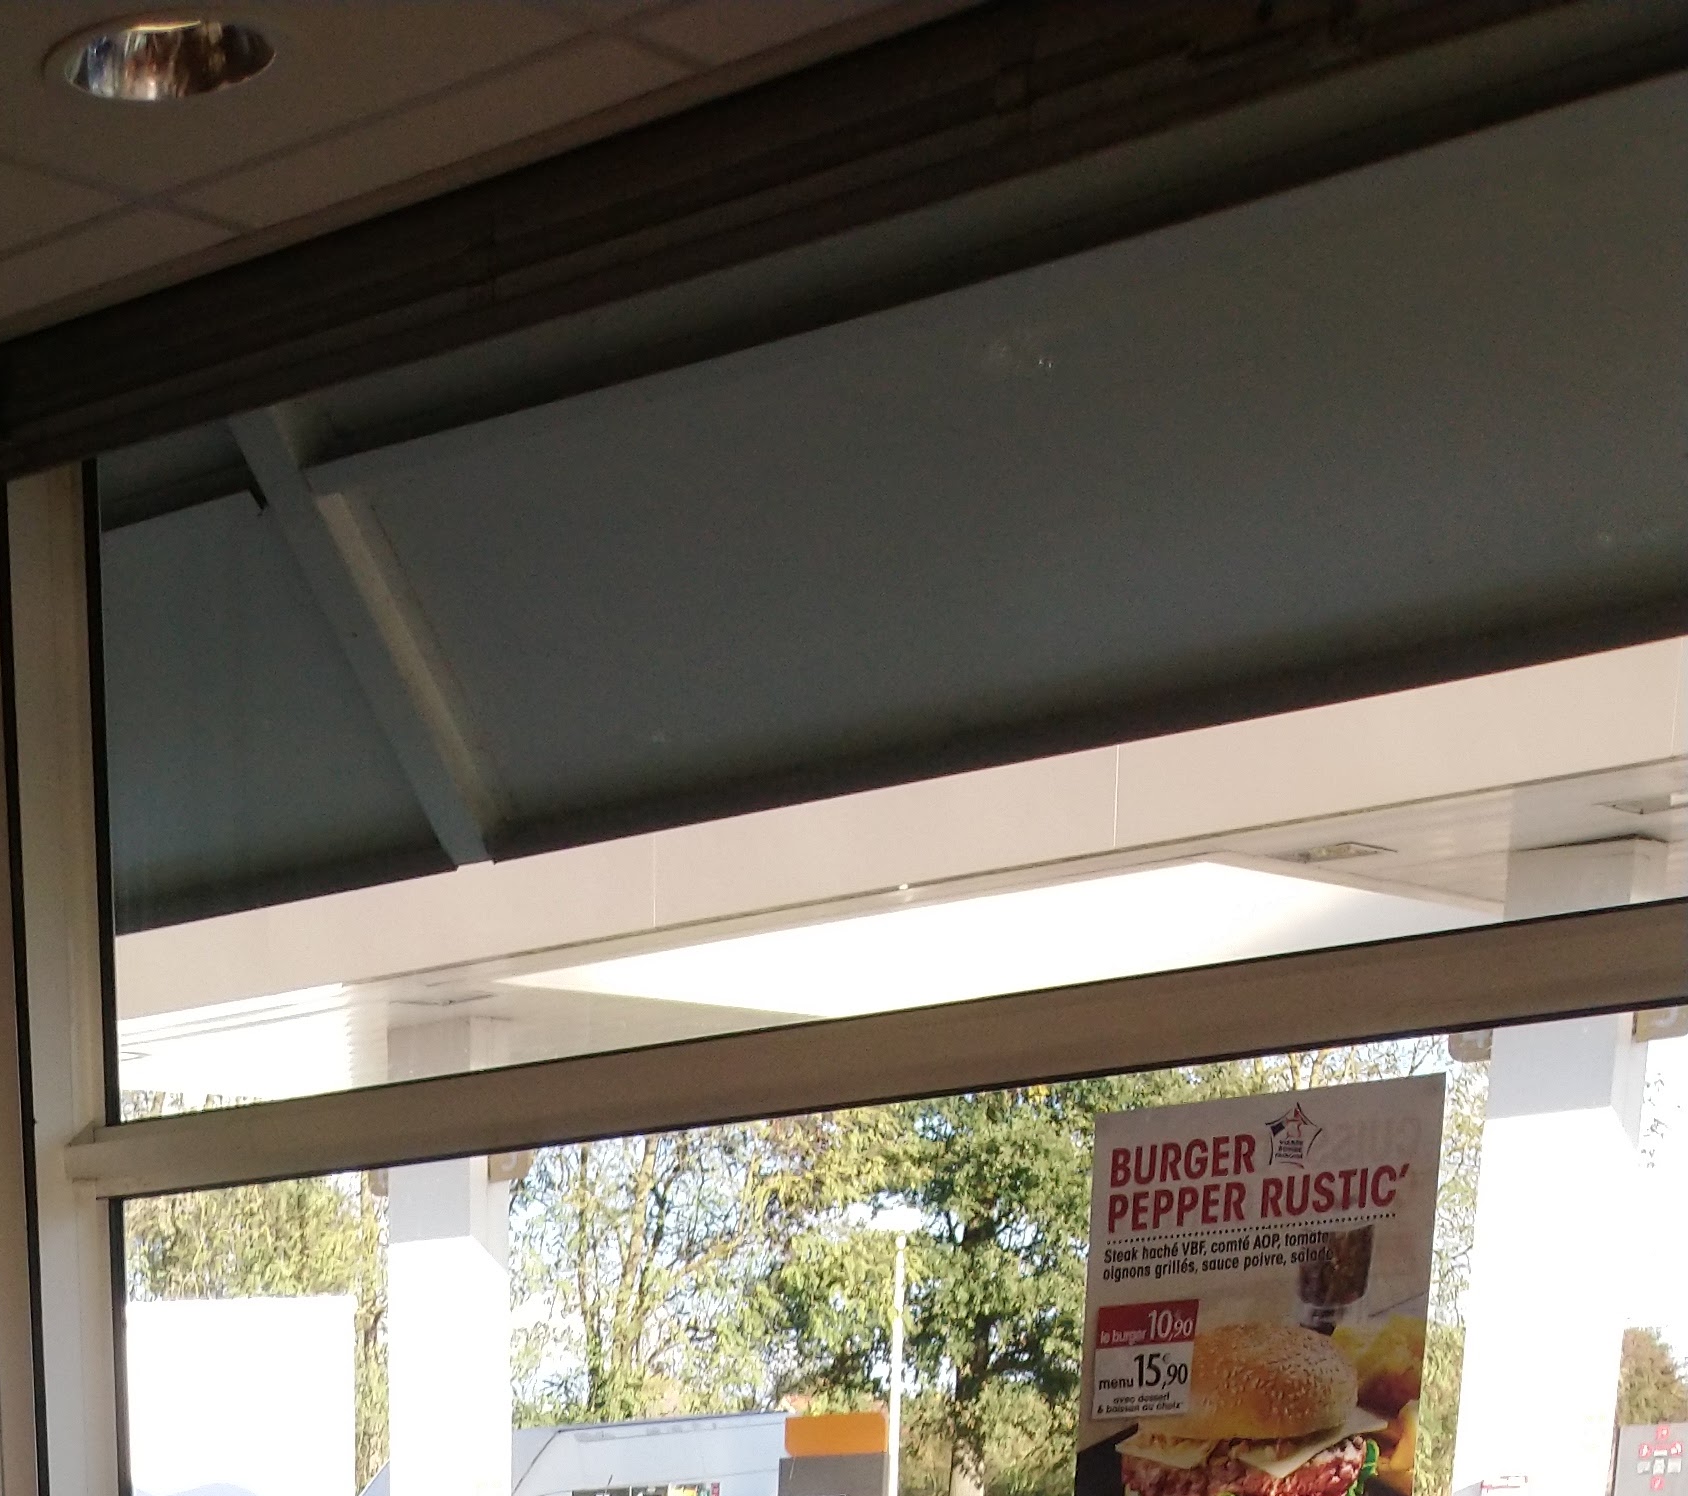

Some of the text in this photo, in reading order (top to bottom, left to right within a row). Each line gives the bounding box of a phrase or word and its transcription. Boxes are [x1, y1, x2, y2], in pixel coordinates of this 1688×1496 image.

[1110, 1133, 1256, 1188] BURGER
[1108, 1163, 1410, 1233] PEPPER RUSTIC'
[1104, 1246, 1138, 1264] Steak
[1142, 1243, 1179, 1260] haché
[1182, 1240, 1207, 1257] VBF,
[1211, 1237, 1250, 1254] comté
[1253, 1234, 1282, 1250] AOP,
[1103, 1265, 1151, 1283] oignons
[1155, 1258, 1199, 1278] grillés,
[1202, 1258, 1239, 1271] sauce
[1244, 1250, 1287, 1272] poivre,
[1112, 1328, 1147, 1346] burger
[1098, 1377, 1134, 1390] menu
